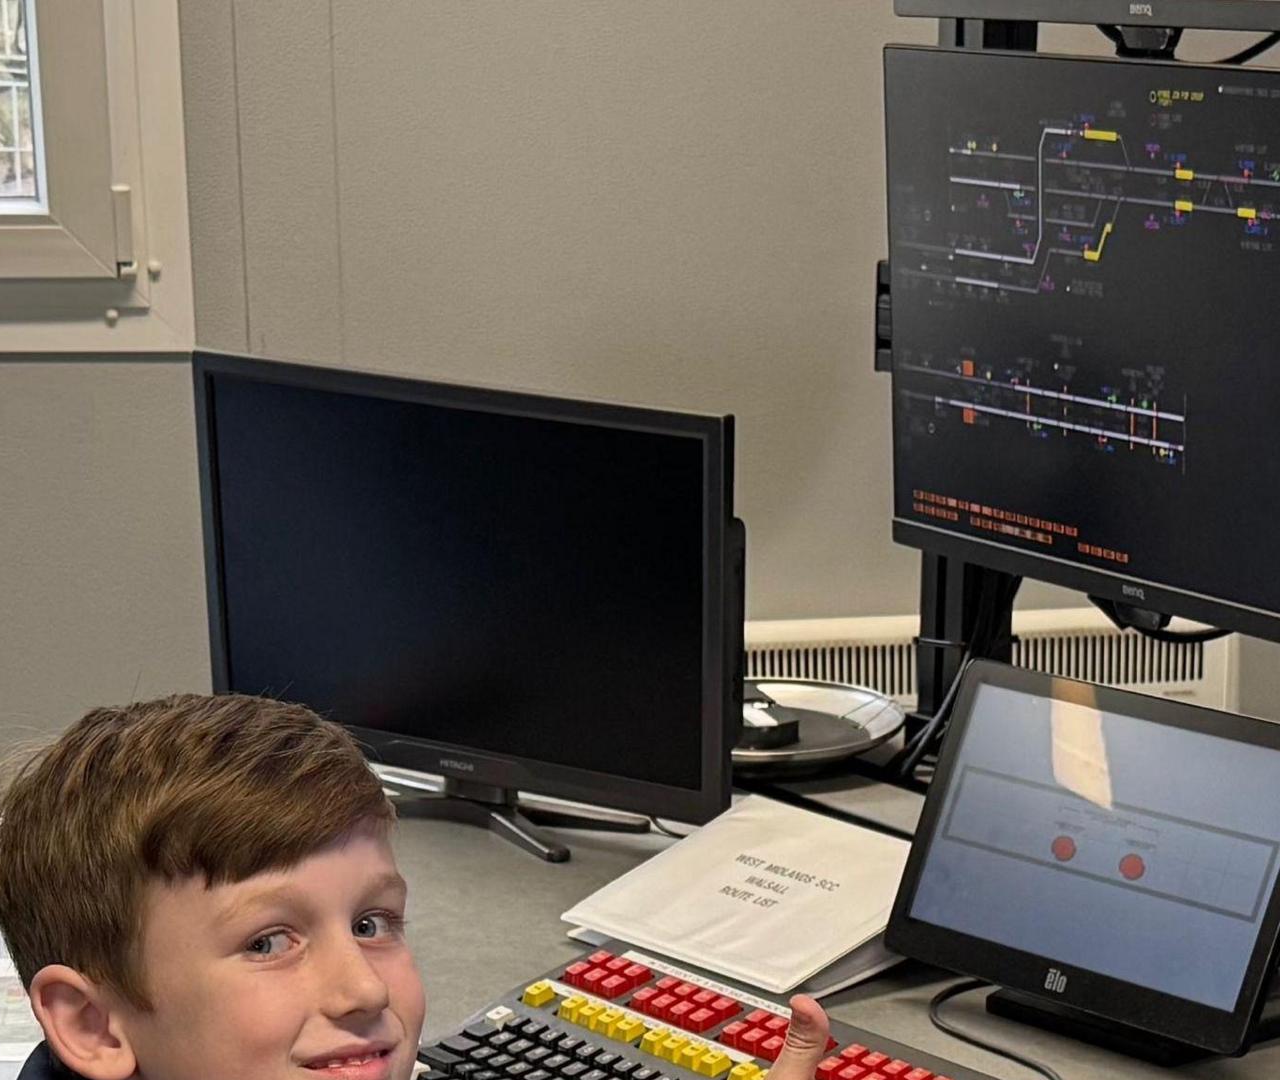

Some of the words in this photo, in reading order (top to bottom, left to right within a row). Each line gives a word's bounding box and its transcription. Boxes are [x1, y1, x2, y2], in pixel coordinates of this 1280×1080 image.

[1129, 3, 1153, 17] BenQ
[439, 758, 475, 773] HITACHI
[735, 852, 763, 869] WEST
[766, 862, 815, 885] MIDLANDS
[816, 879, 840, 893] SCC
[745, 874, 790, 895] WALSALL
[718, 885, 750, 902] ROUTE
[751, 895, 779, 910] LIST
